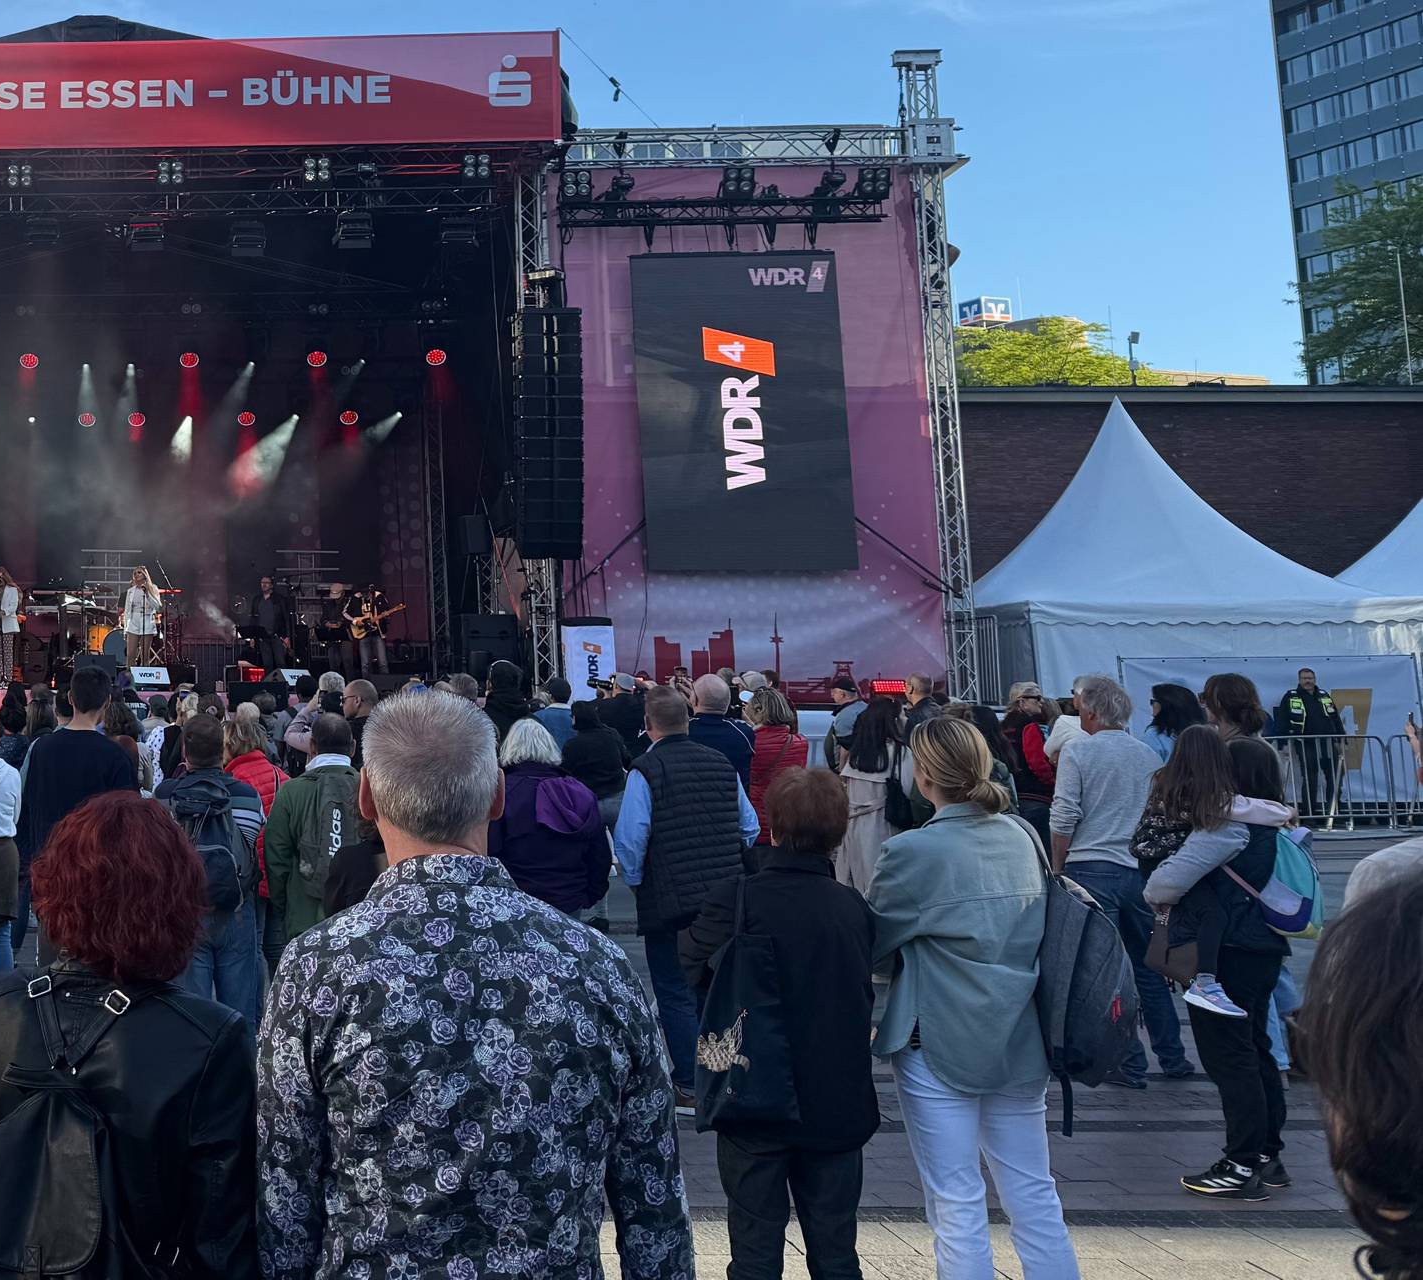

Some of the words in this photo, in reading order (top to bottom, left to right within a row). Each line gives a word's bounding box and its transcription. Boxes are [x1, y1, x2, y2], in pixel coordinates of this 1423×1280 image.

[60, 79, 194, 110] ESSEN
[242, 70, 391, 106] BÜHNE
[748, 267, 806, 286] WDR
[721, 374, 767, 491] WDR
